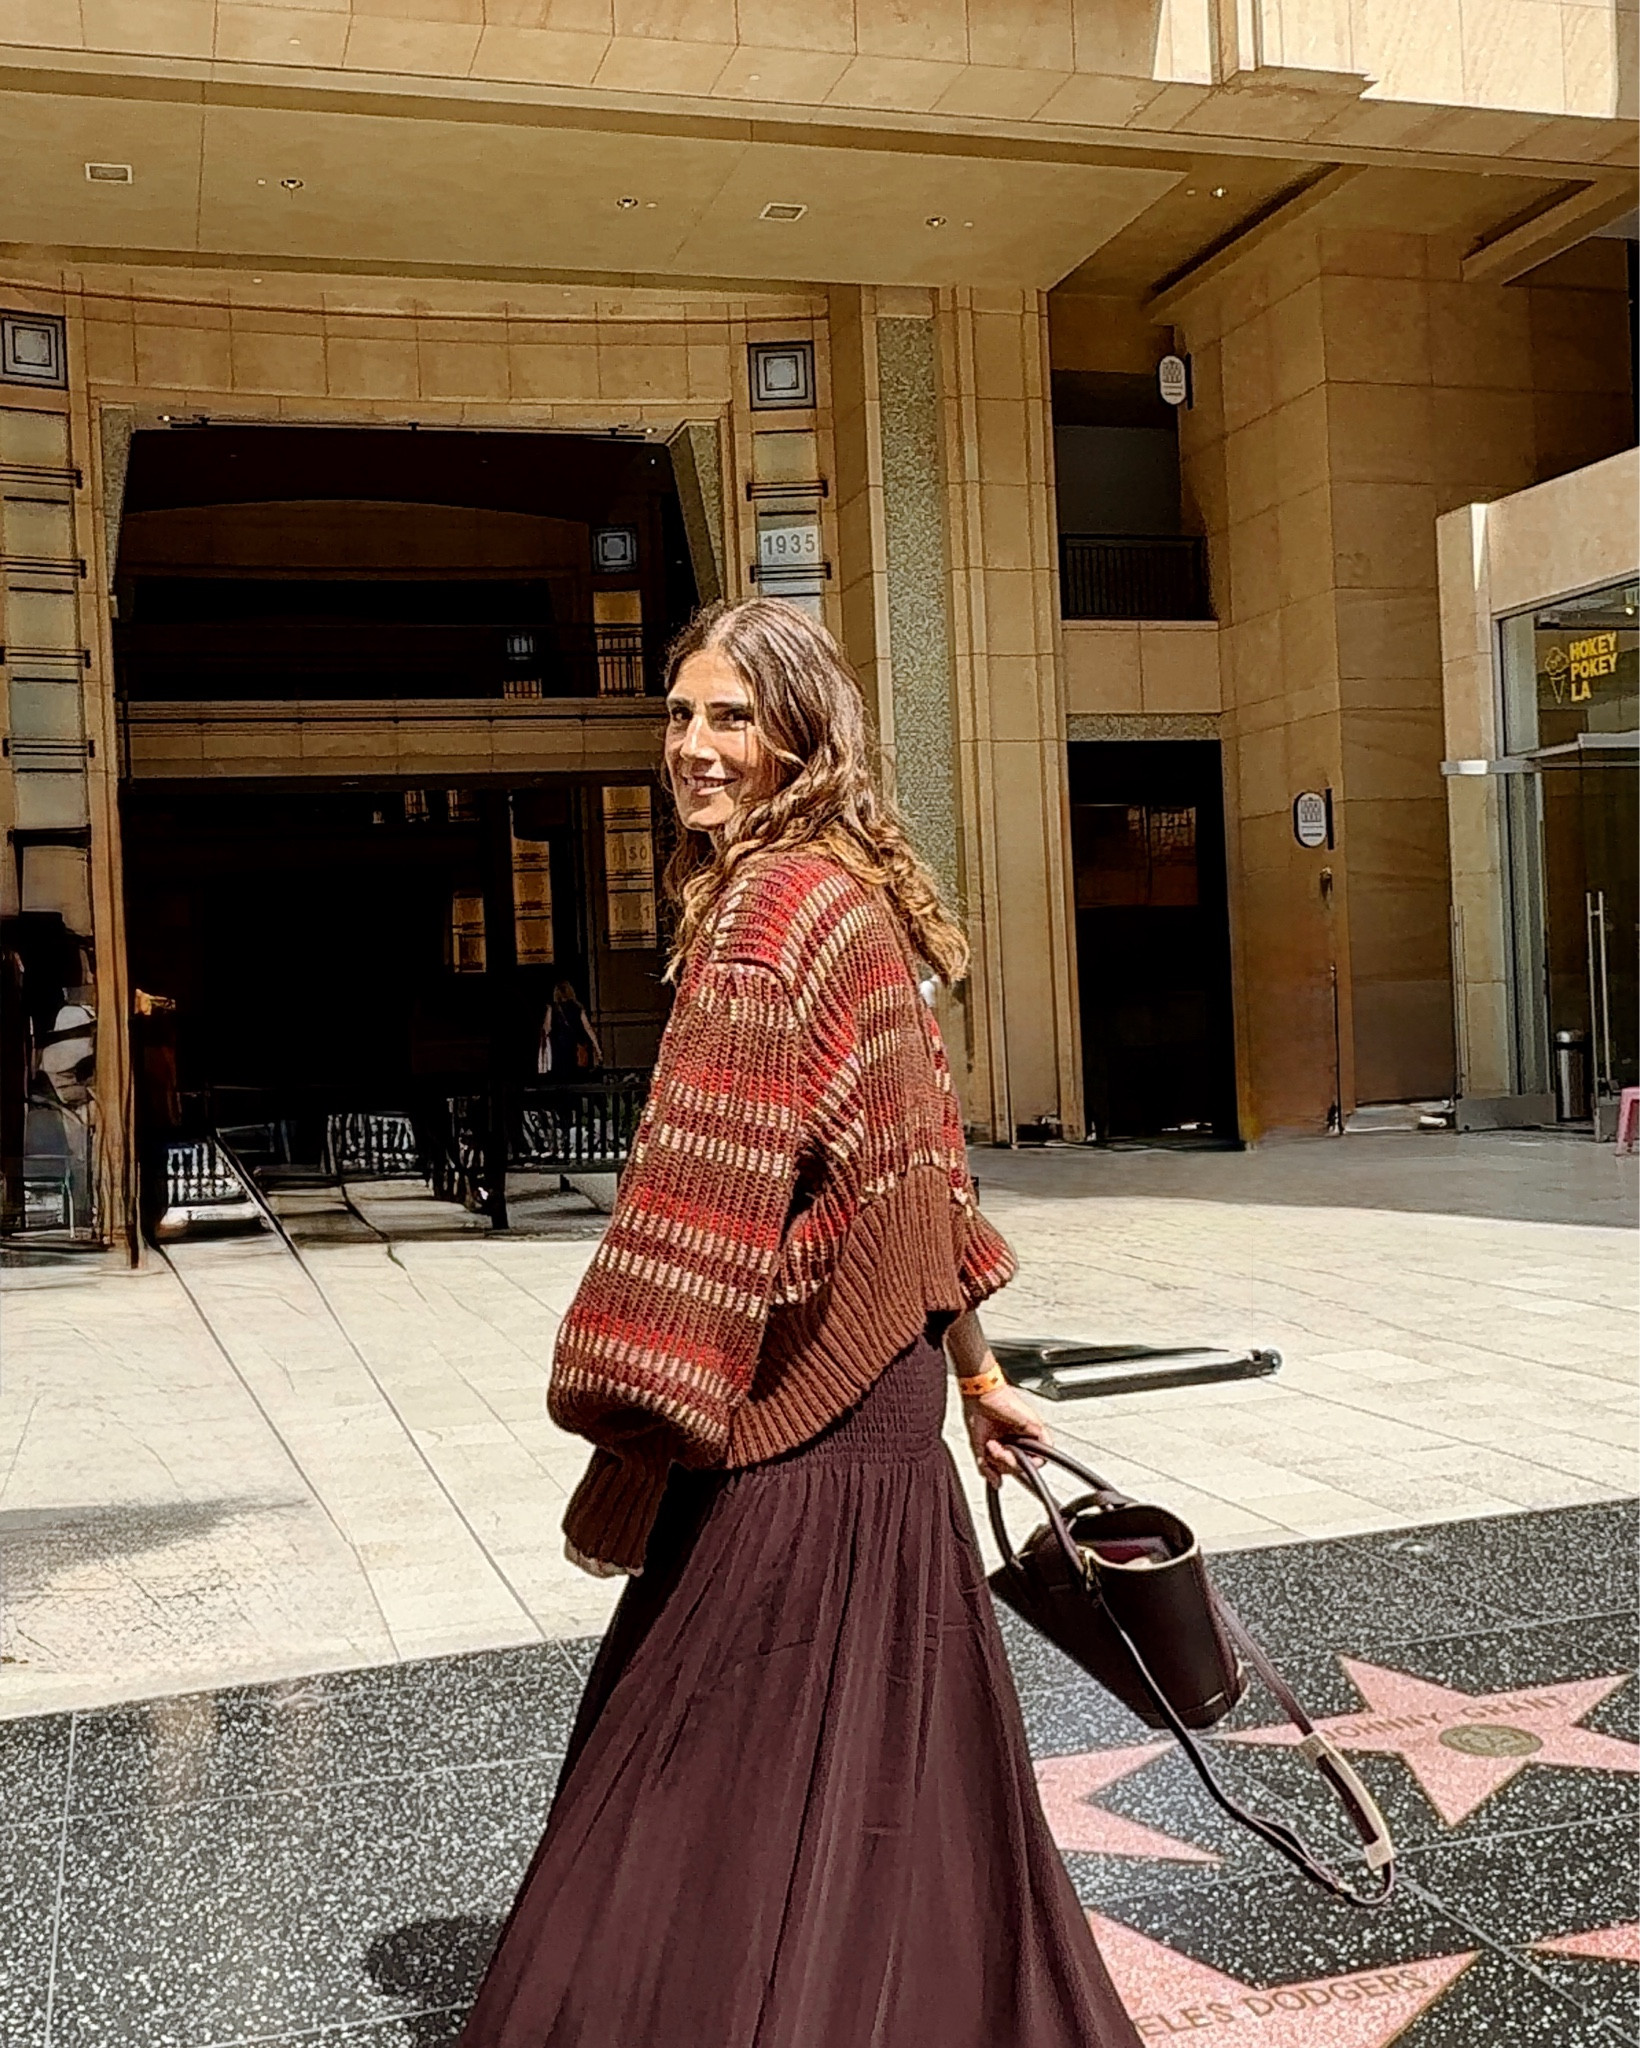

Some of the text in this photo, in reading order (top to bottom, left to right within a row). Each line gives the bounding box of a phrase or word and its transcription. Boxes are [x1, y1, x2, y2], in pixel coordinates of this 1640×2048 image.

[763, 533, 816, 556] 1935
[1569, 631, 1618, 661] HOKEY
[1570, 651, 1619, 682] POKEY
[1570, 680, 1593, 702] LA
[1321, 1694, 1568, 1740] JOHNNY GRANT
[1241, 1969, 1429, 2018] DODGERS
